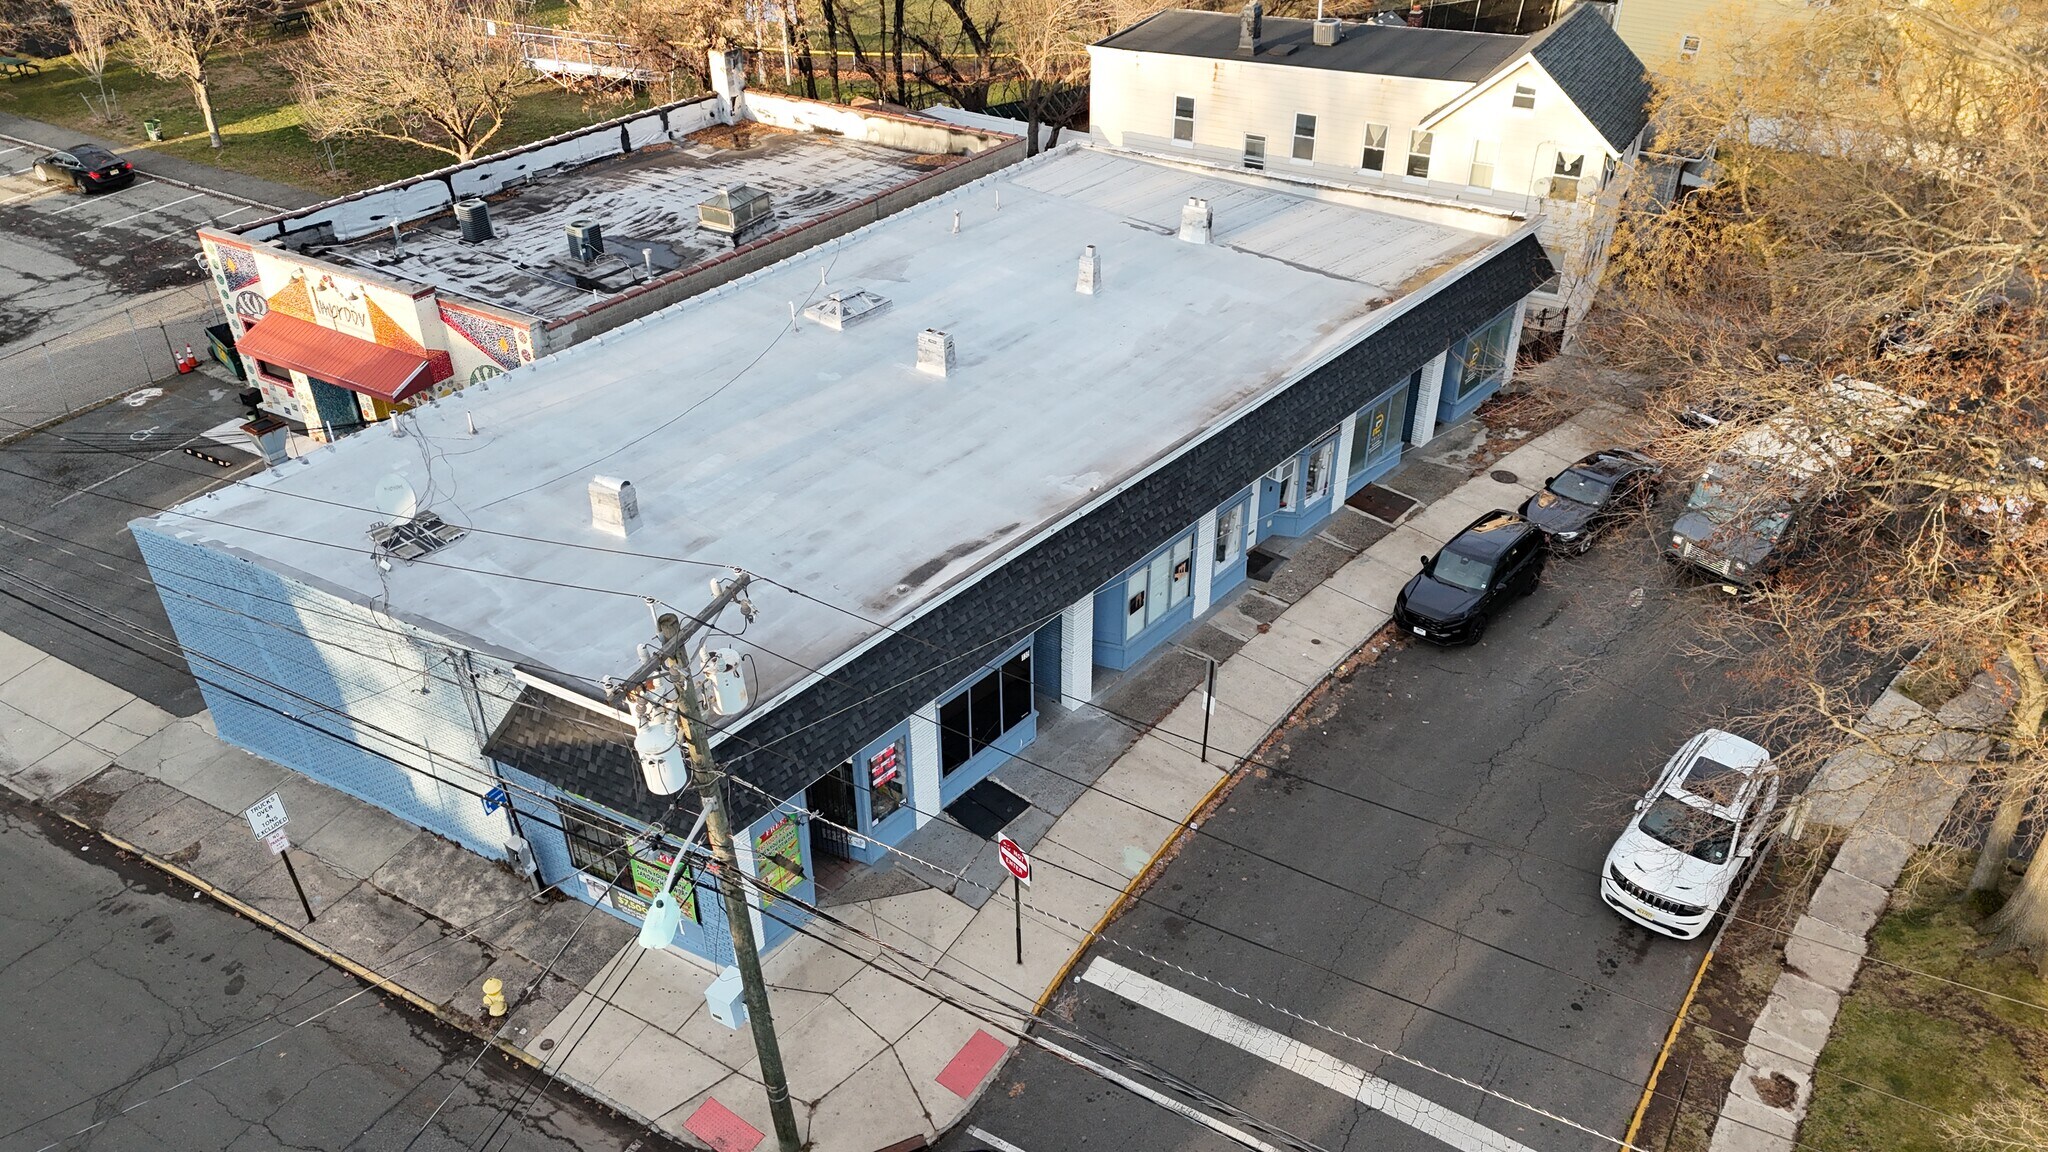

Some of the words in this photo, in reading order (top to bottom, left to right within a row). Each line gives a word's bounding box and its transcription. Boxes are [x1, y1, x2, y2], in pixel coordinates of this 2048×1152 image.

[251, 797, 275, 813] TRUCKS
[257, 804, 274, 817] OVER
[257, 816, 287, 837] EXCLUDED
[261, 815, 279, 828] TONS
[1013, 850, 1024, 862] NOT
[1005, 856, 1023, 875] ENTER
